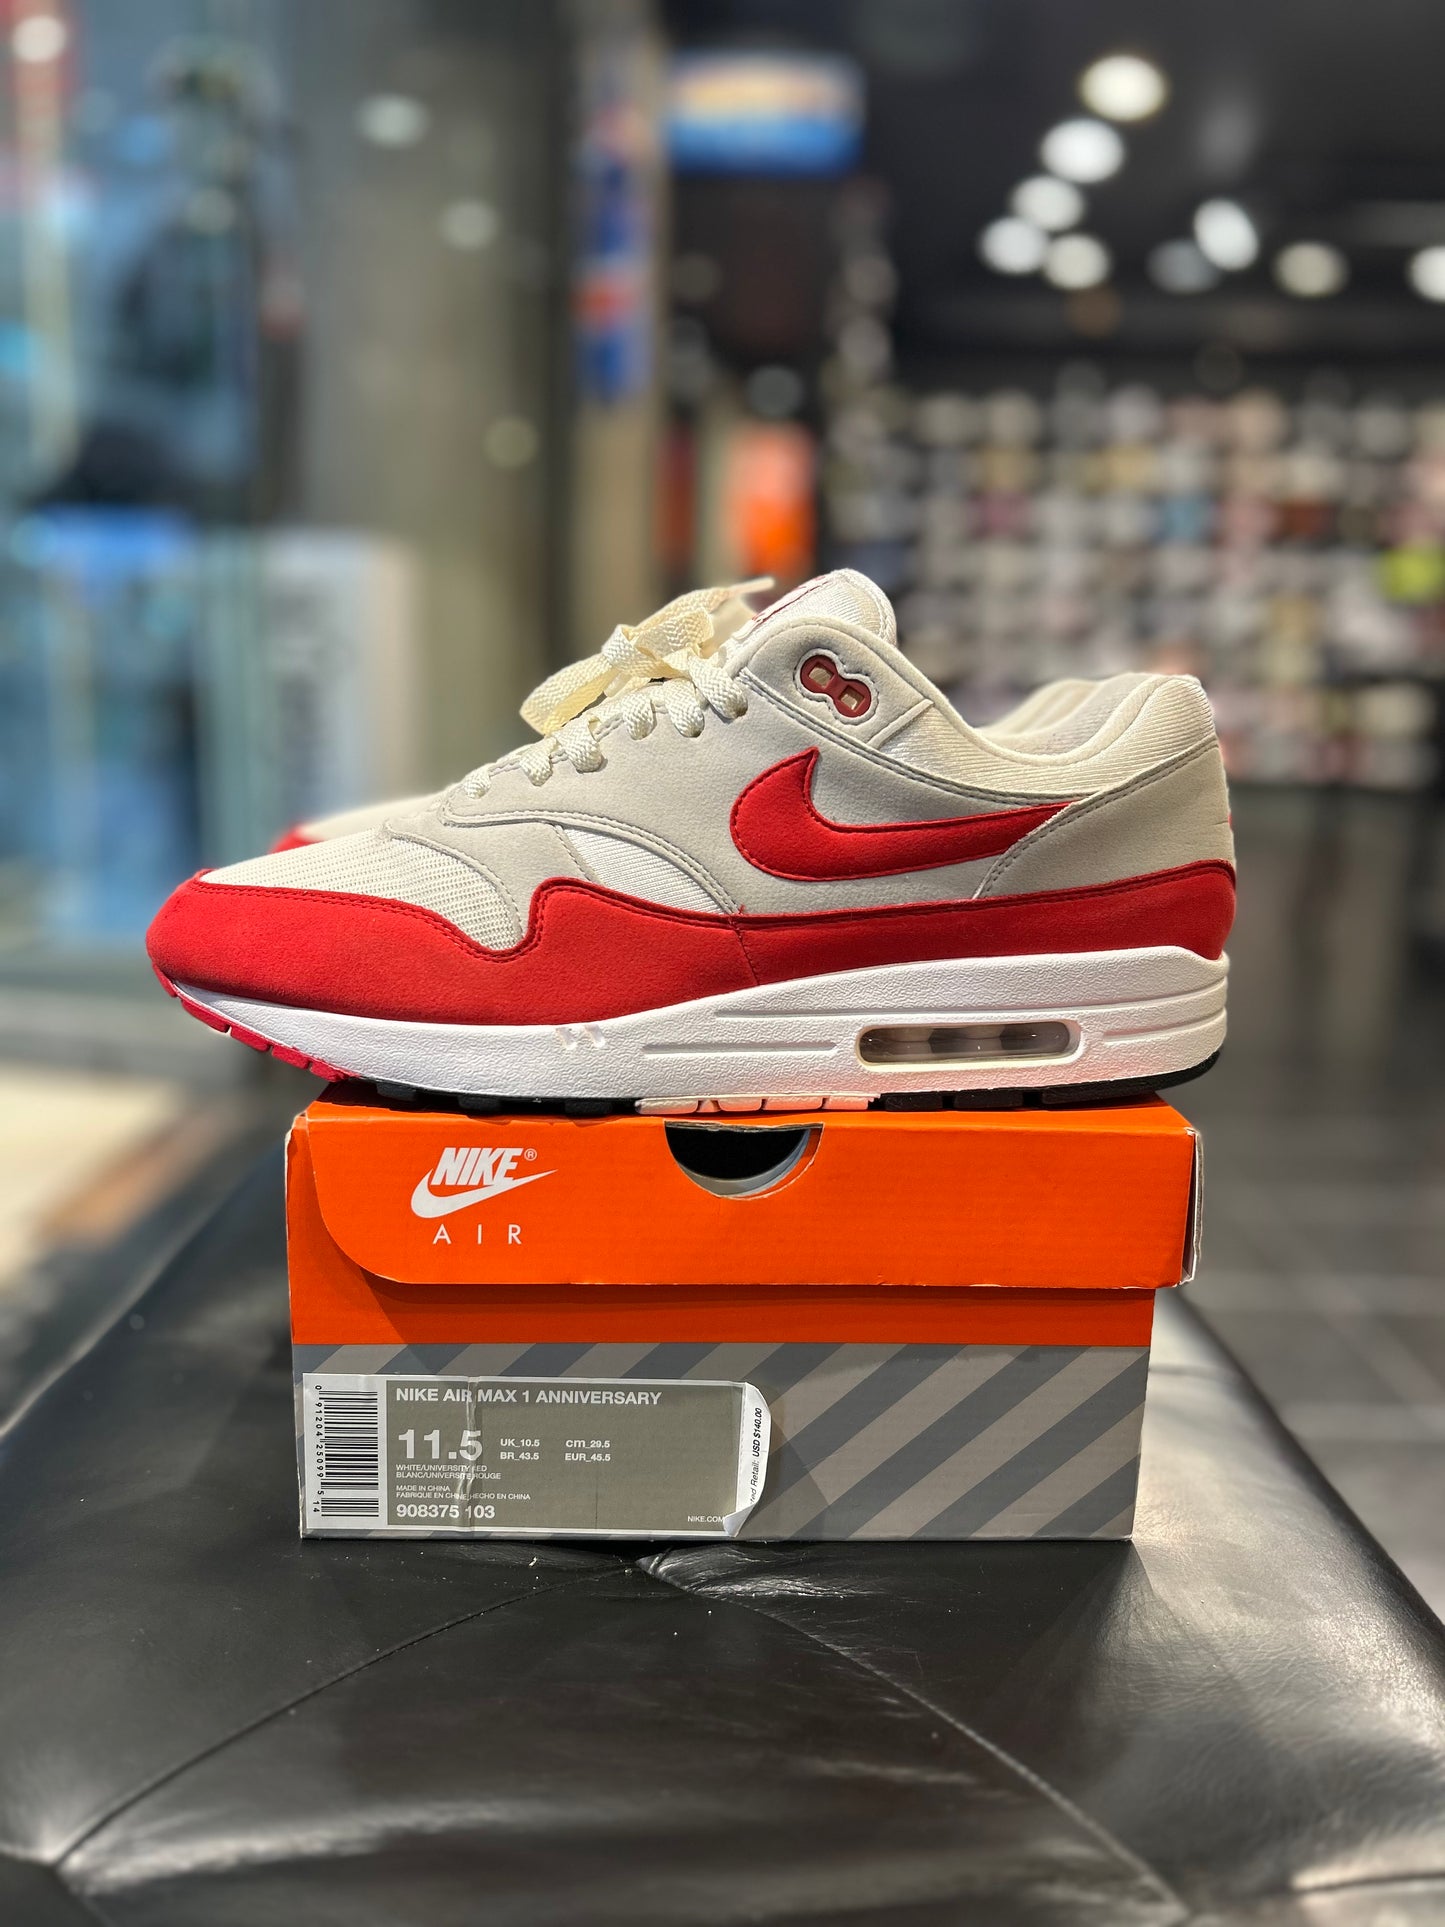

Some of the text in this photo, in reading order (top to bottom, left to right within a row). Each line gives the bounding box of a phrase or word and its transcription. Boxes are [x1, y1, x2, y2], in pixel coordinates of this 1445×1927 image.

[432, 1223, 522, 1245] AIR
[396, 1388, 662, 1405] NIKE AIR MAX 1 ANNIVERSARY
[315, 1402, 323, 1437] 91204
[753, 1407, 762, 1439] $140.00
[398, 1429, 483, 1461] 11.5
[500, 1438, 541, 1448] UK_10.5
[752, 1439, 761, 1457] USD
[316, 1444, 324, 1478] 25099
[500, 1452, 612, 1462] BR_43.5 EUR_45.5
[396, 1464, 471, 1472] WHITE/UNIVERSITY
[473, 1472, 502, 1480] ROUGE
[750, 1460, 759, 1488] Retail:
[427, 1485, 451, 1493] CHINA
[313, 1501, 320, 1513] 14
[396, 1504, 496, 1519] 908375 103
